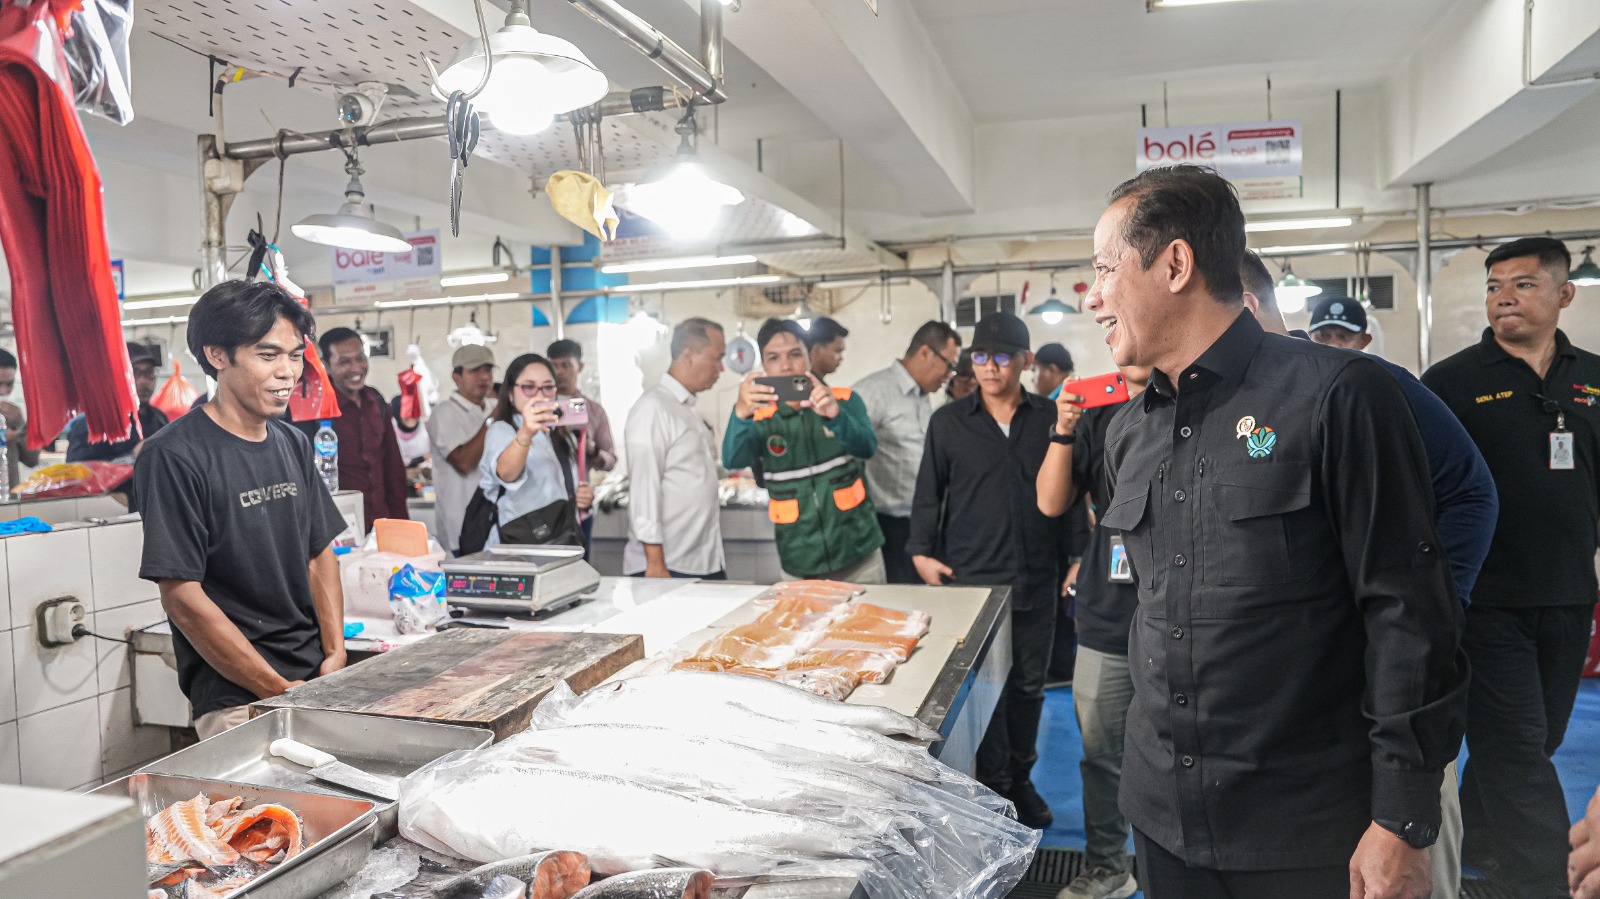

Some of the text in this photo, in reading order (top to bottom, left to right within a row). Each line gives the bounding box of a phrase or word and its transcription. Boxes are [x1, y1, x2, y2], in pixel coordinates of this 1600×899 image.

[1144, 131, 1216, 161] balé
[1475, 390, 1513, 403] SENA ATEP
